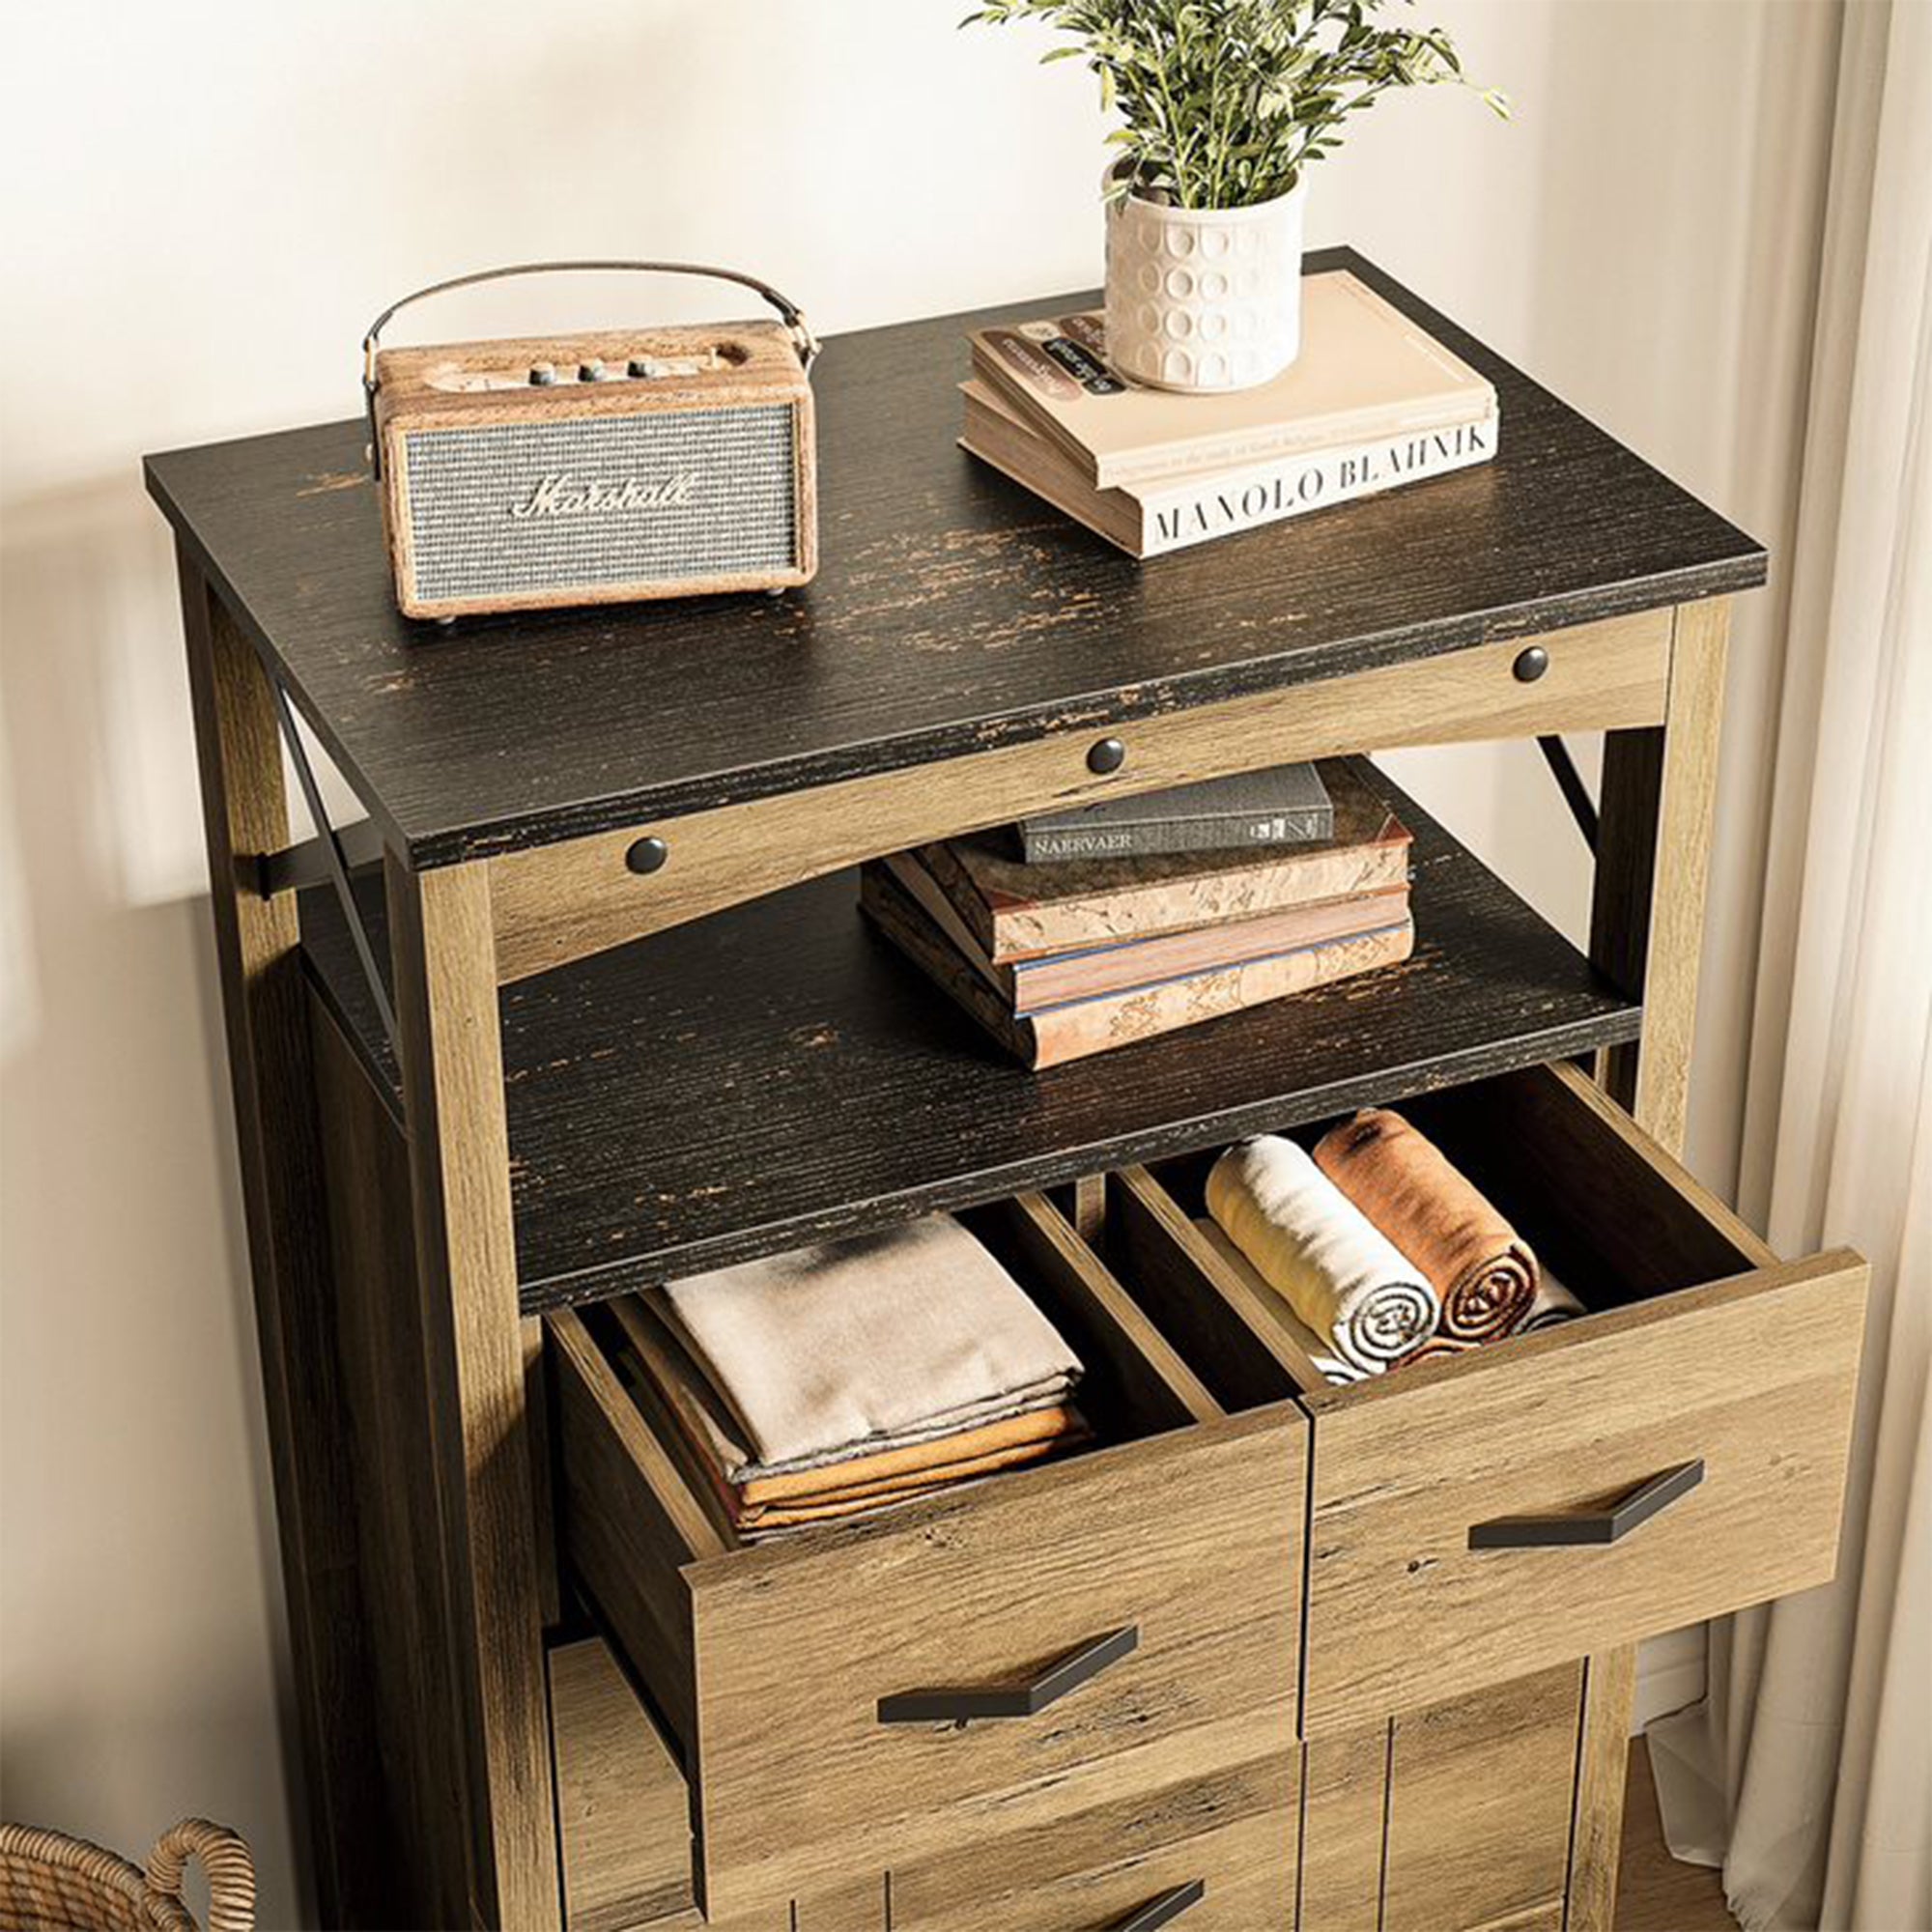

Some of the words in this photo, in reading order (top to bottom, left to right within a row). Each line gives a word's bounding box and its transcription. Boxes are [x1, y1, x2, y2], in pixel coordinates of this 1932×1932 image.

[512, 473, 698, 517] Marshall
[1154, 468, 1323, 544] MANOLO
[1339, 425, 1486, 489] BLAHNIK
